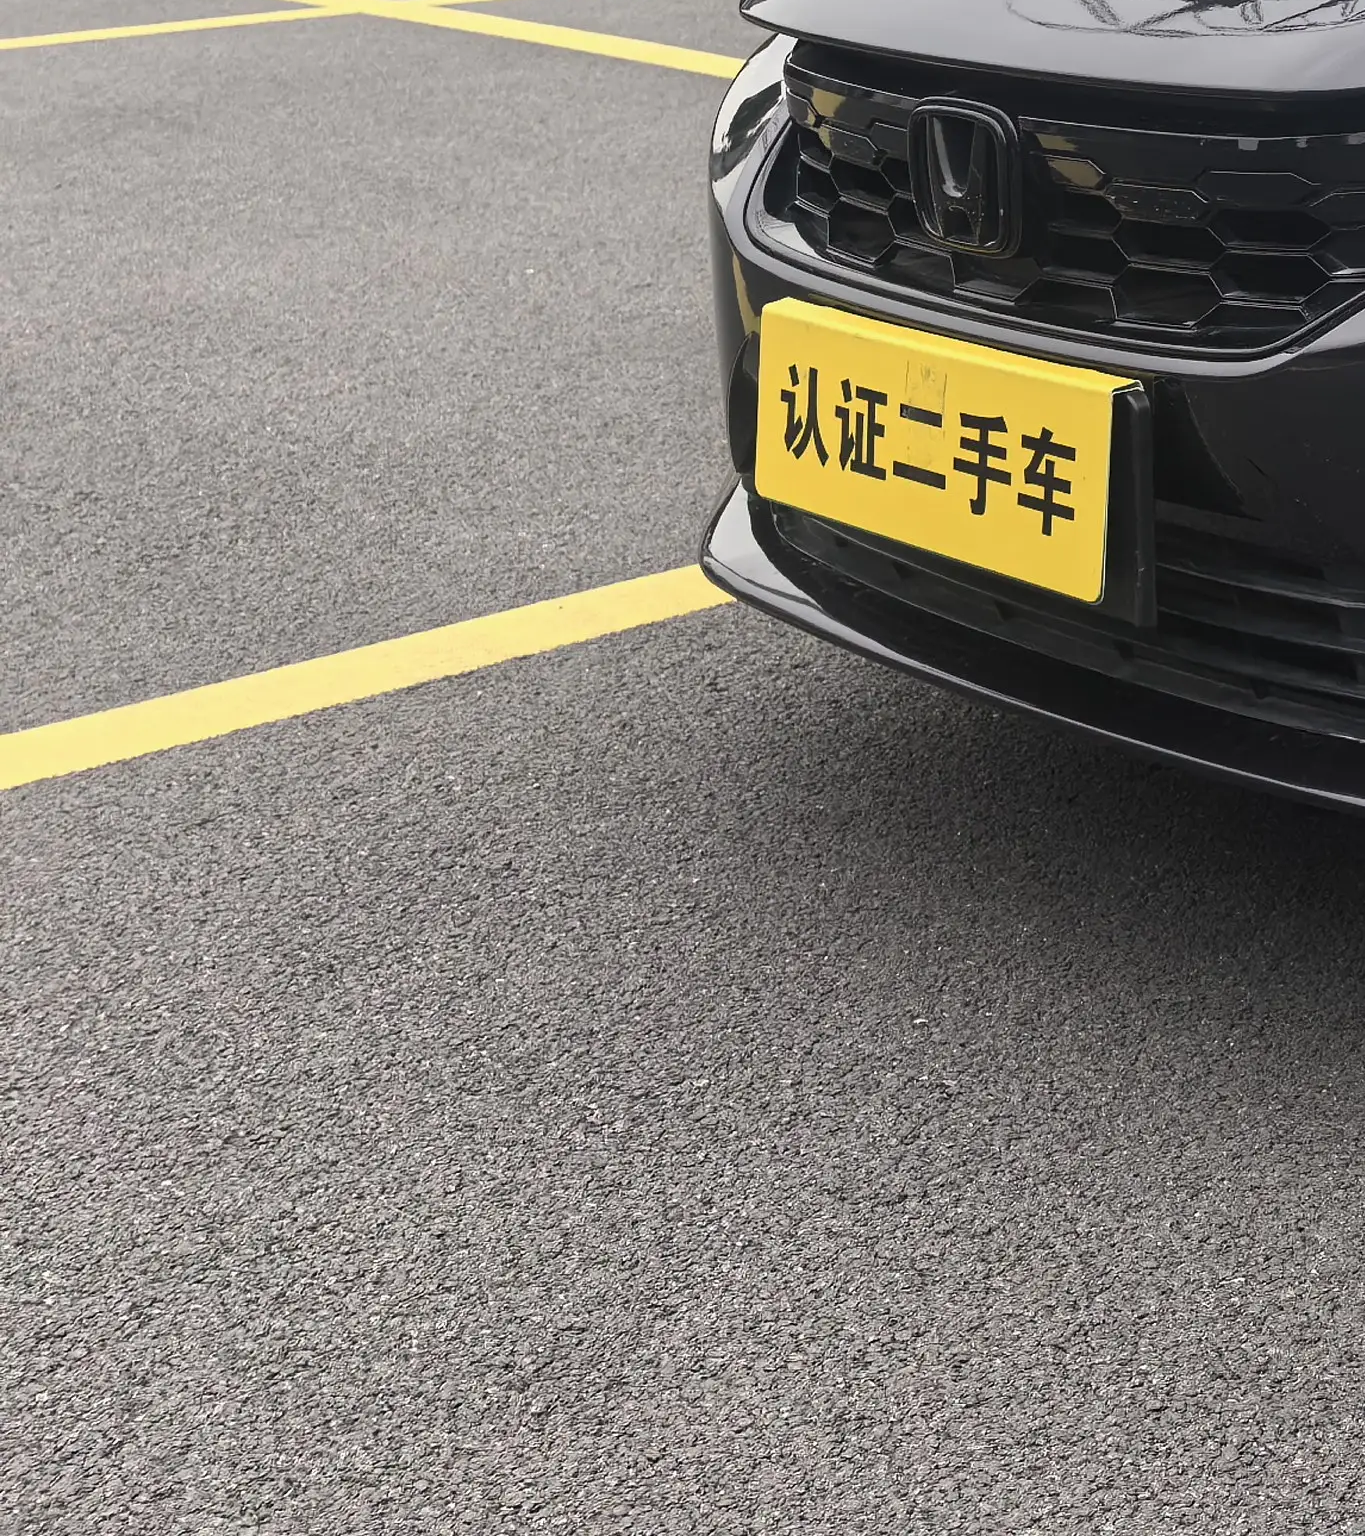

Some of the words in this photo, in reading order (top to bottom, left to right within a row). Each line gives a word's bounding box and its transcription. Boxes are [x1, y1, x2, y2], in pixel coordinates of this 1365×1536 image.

[780, 364, 1077, 537] 认证二手车
